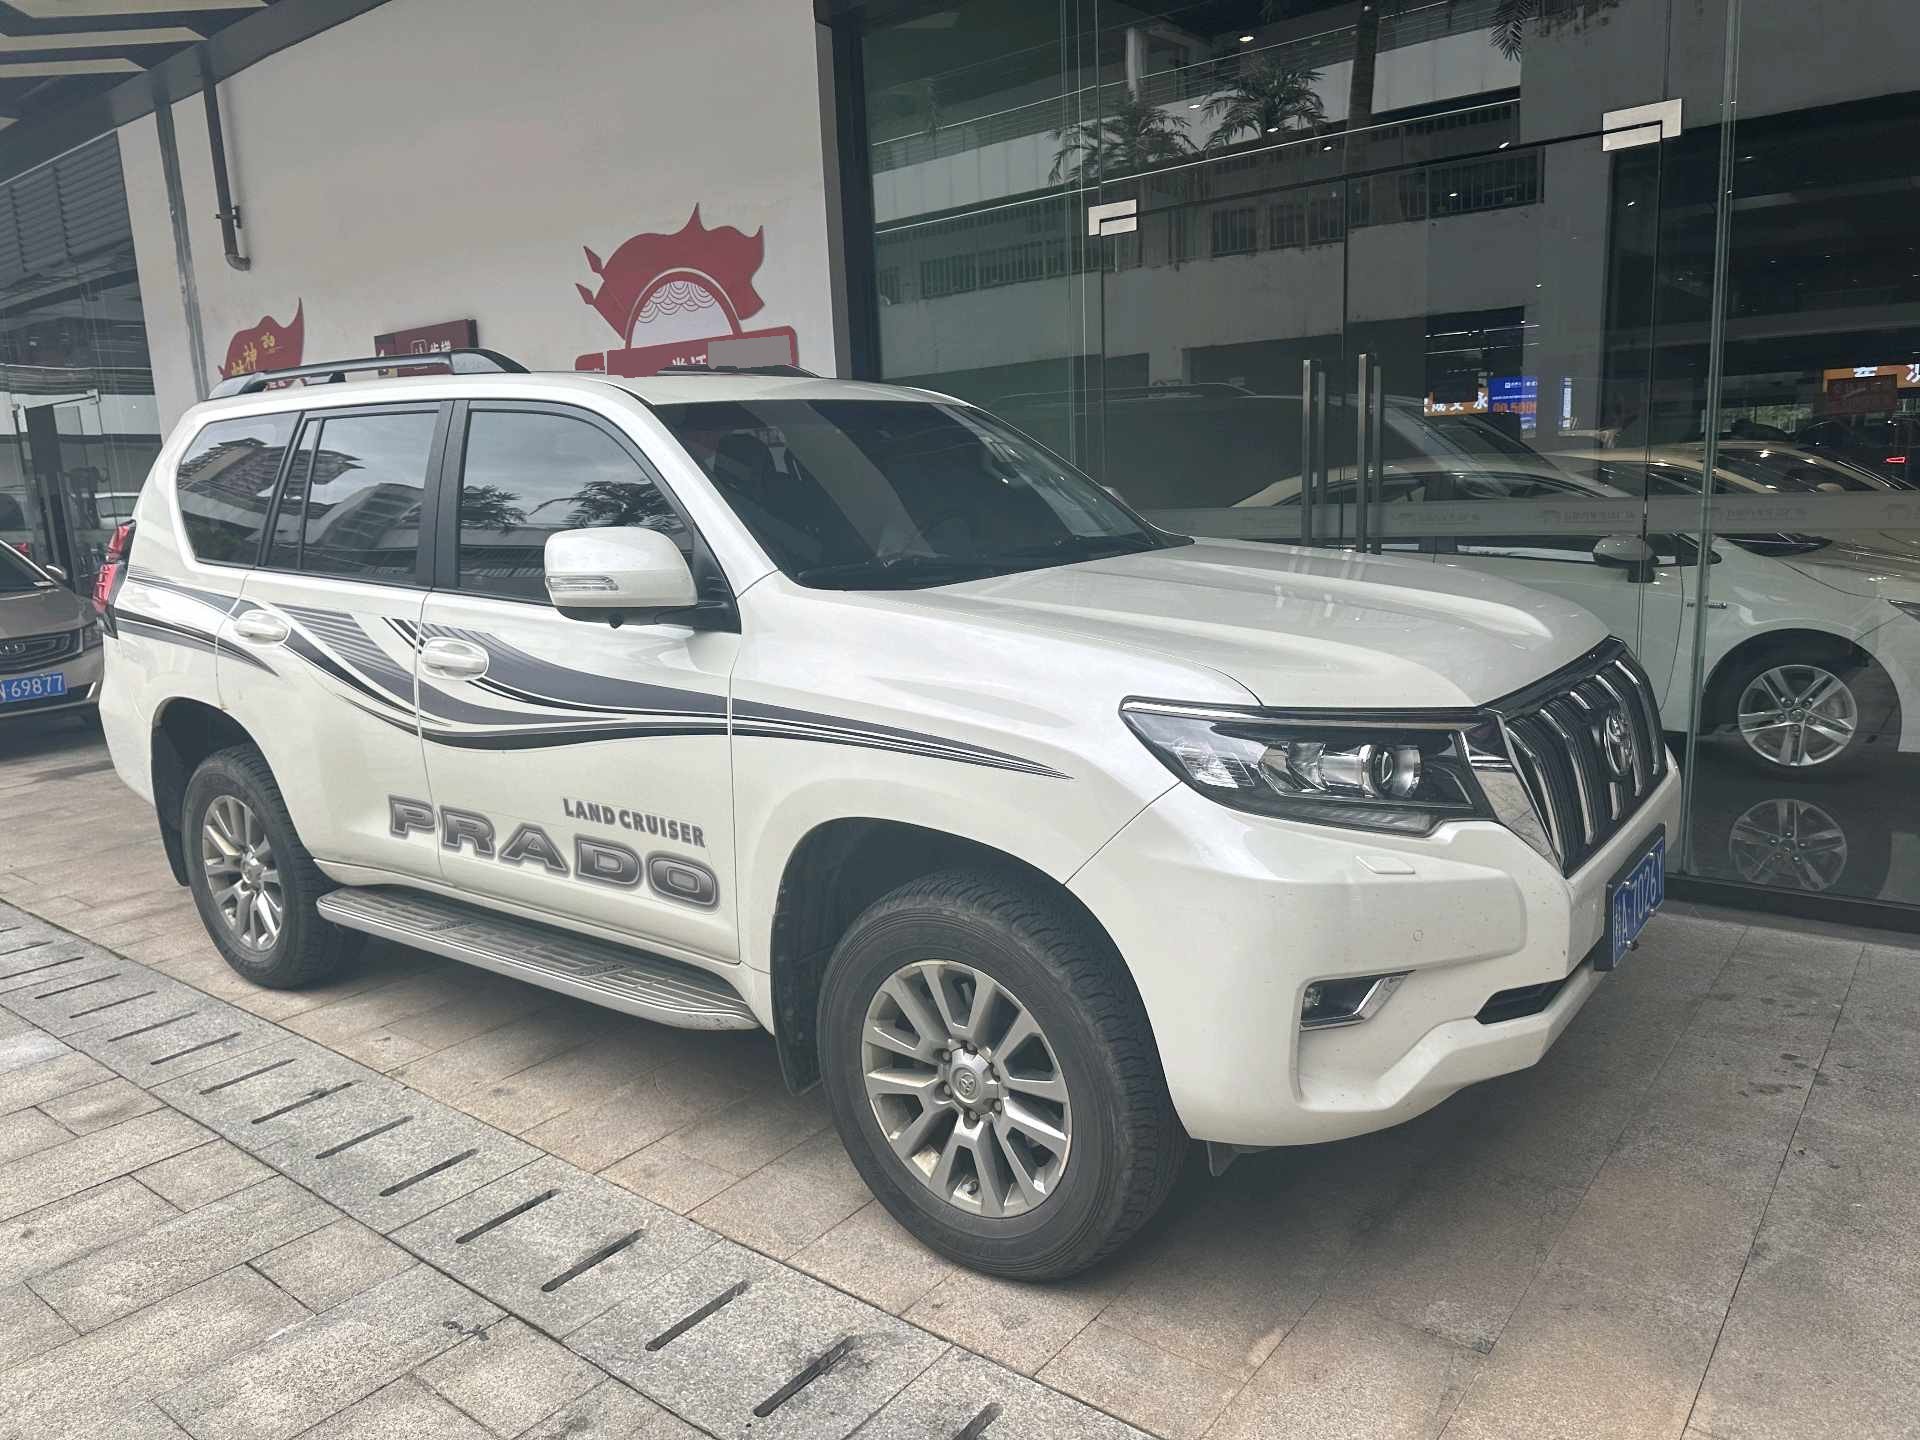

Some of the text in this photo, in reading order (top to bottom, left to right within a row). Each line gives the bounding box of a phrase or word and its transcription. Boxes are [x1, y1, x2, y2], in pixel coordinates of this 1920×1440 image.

[388, 795, 719, 908] PRADO
[563, 798, 706, 848] LAND CRUISER
